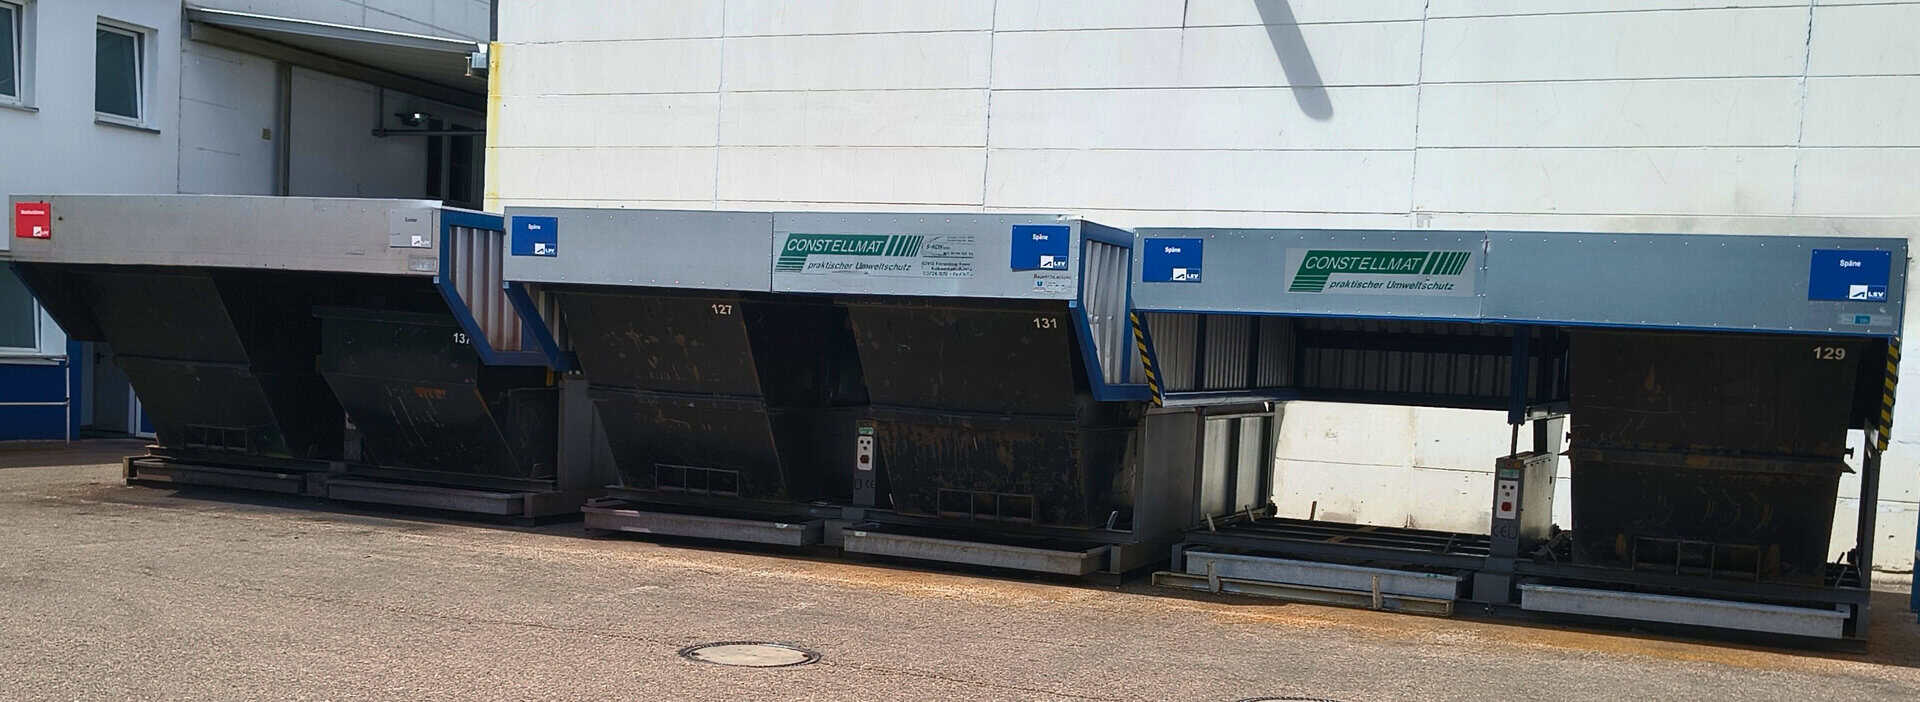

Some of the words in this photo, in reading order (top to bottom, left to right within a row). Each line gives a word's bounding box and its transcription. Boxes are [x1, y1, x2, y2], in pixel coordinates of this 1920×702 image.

[787, 238, 884, 253] CONSTELLMAT
[807, 260, 853, 270] praktischer
[855, 261, 912, 272] Umweltschutz
[1305, 255, 1422, 271] CONSTELLMAT
[1839, 259, 1861, 268] Späne
[1329, 279, 1384, 289] praktischer
[1386, 280, 1455, 291] Umweltschutz
[711, 303, 732, 315] 127
[1033, 317, 1057, 329] 131
[1813, 346, 1846, 360] 129
